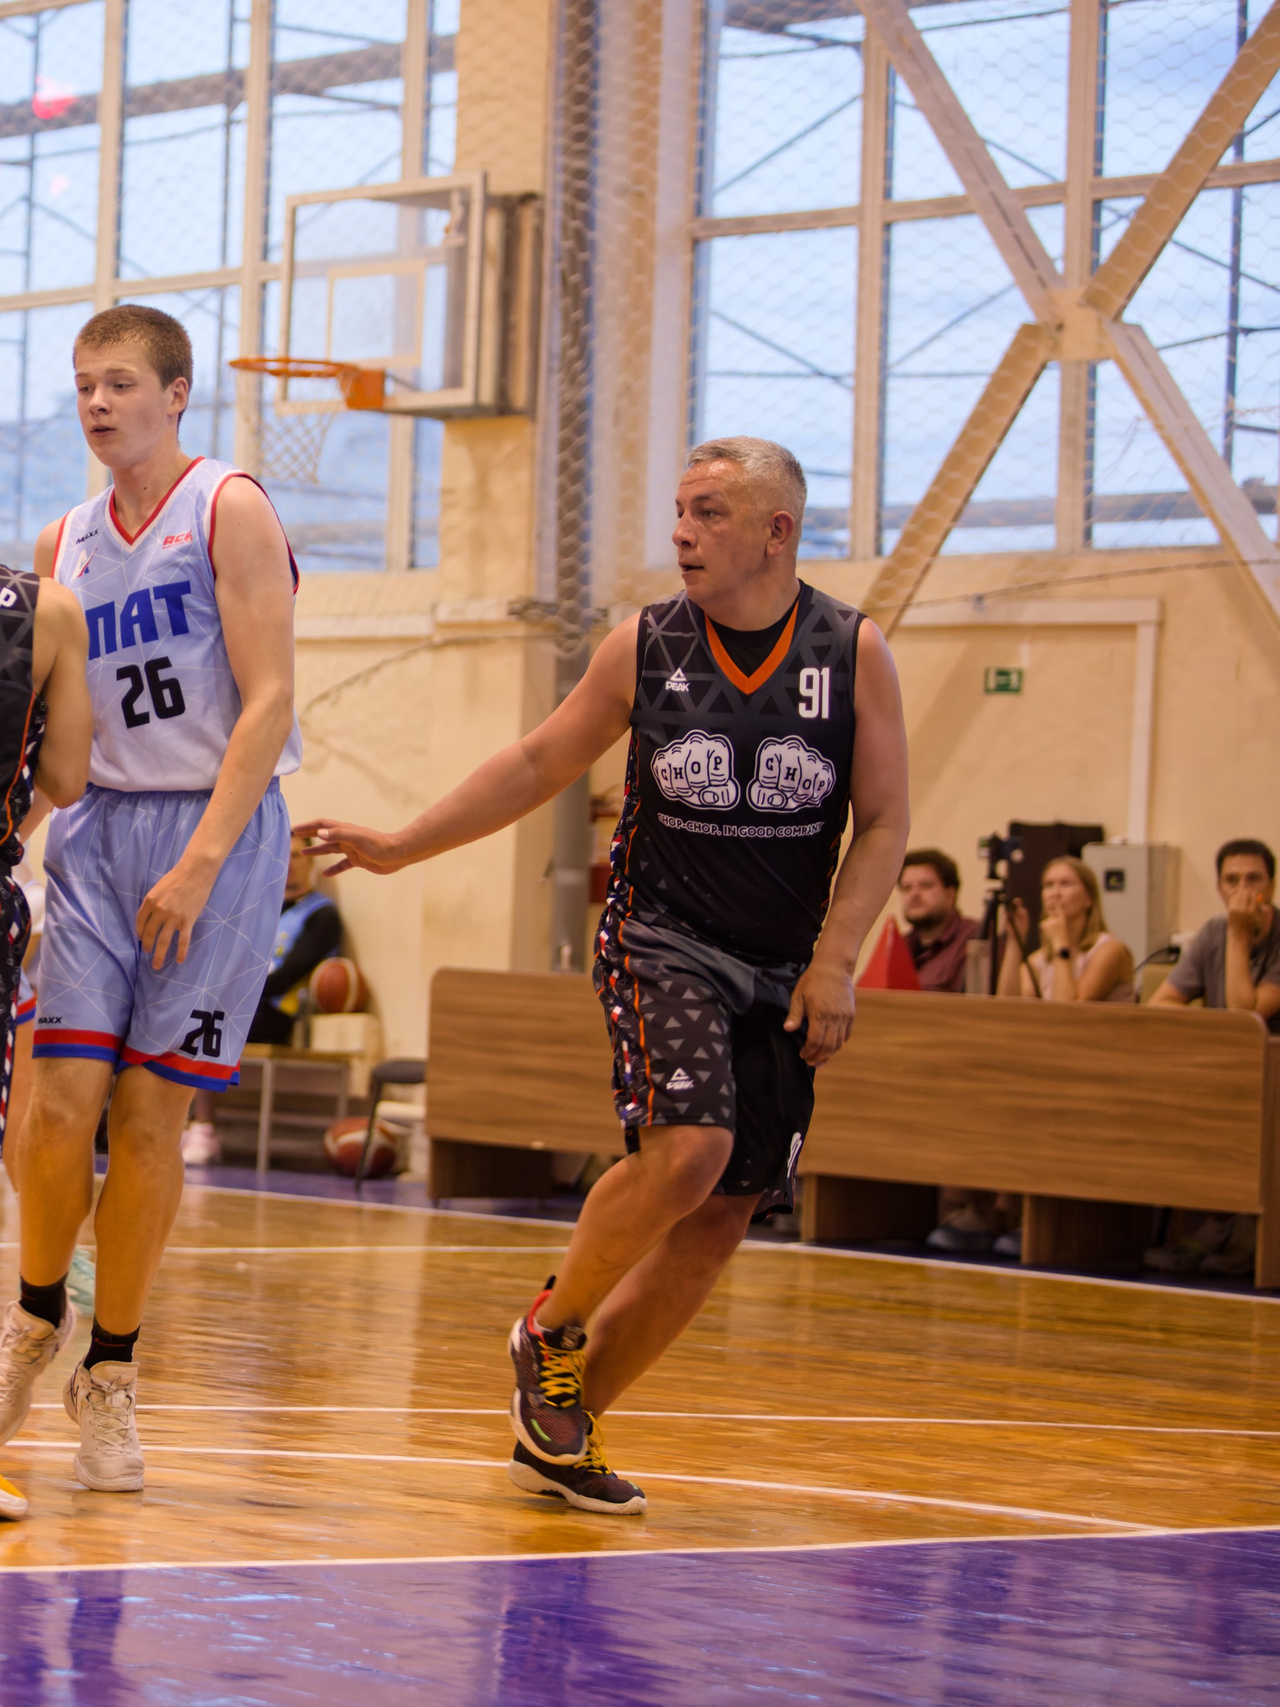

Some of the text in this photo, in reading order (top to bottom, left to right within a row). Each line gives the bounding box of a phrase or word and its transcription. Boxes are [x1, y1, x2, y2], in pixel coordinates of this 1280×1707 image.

[85, 581, 191, 660] ПАТ
[116, 656, 186, 729] 26
[665, 681, 690, 692] PEAK
[798, 667, 830, 719] 91
[660, 755, 722, 782] CHOP
[765, 757, 825, 791] CHOP
[723, 825, 737, 837] IN
[738, 826, 775, 838] GOOD
[179, 1009, 225, 1058] 26
